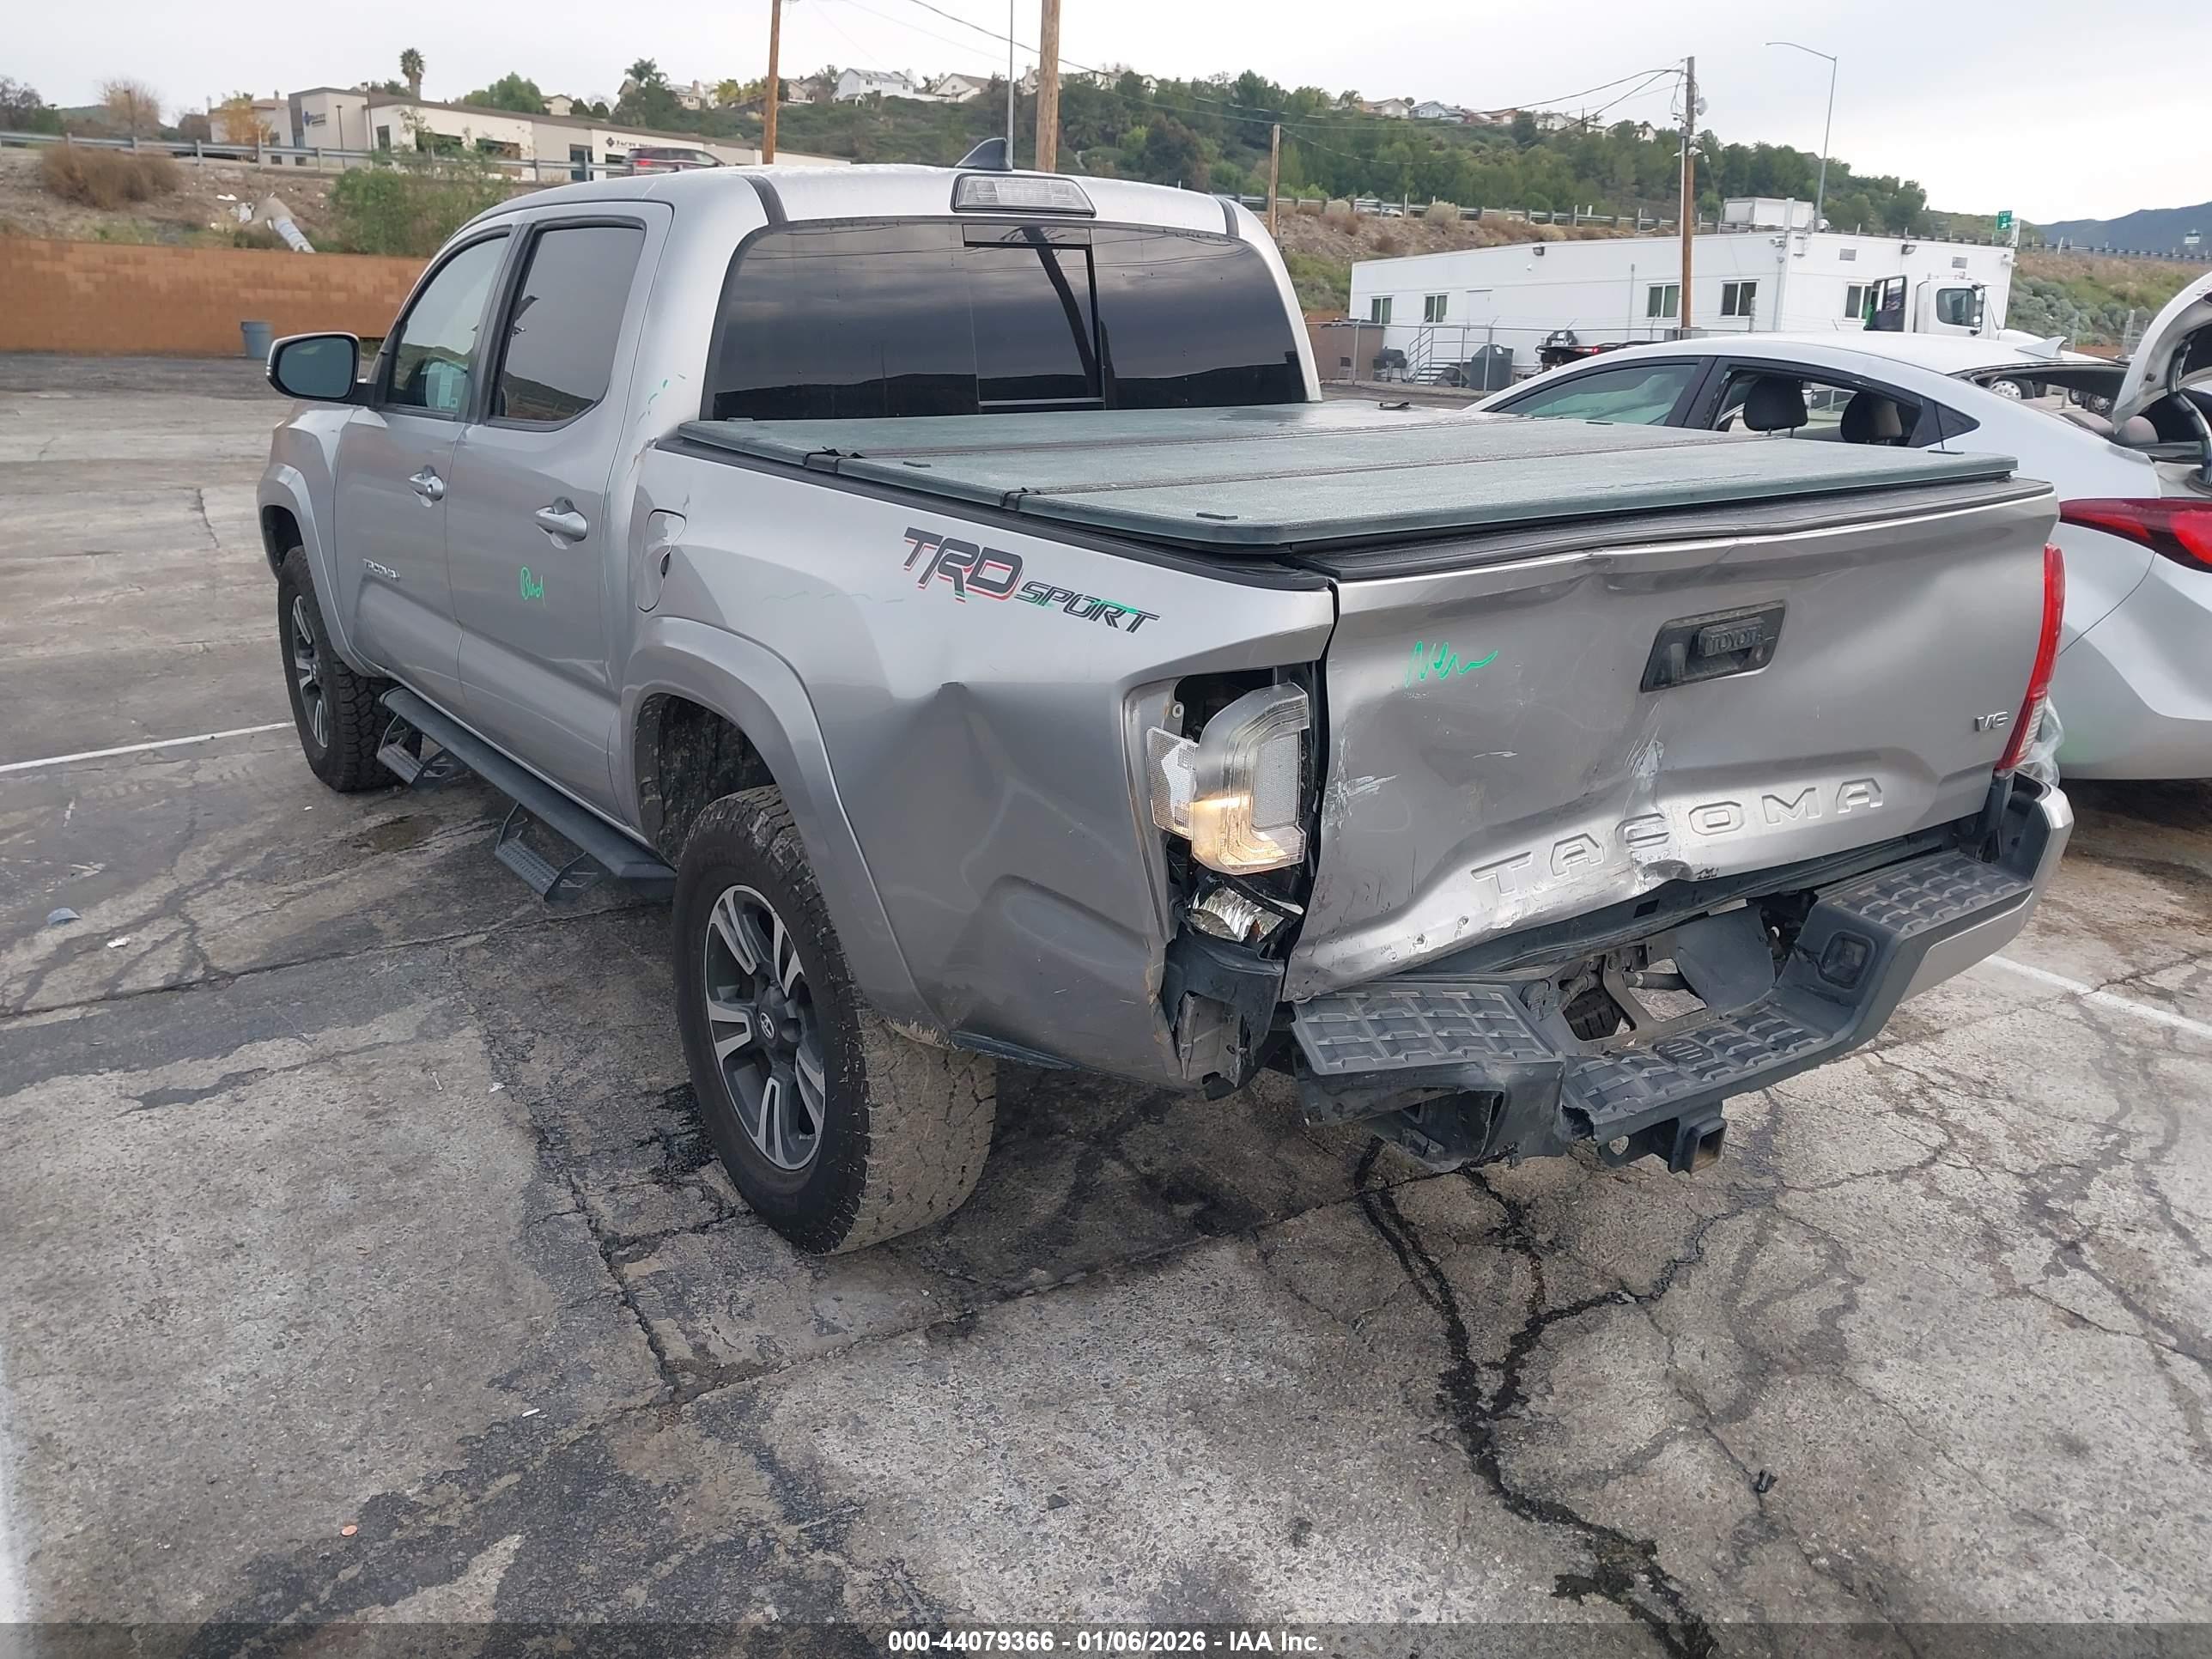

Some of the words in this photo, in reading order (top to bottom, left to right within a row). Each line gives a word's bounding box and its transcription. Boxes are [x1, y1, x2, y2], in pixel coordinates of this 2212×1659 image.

[903, 526, 1024, 603] TRD
[1013, 580, 1161, 634] SPORT
[1974, 711, 2009, 732] V6
[1469, 777, 1885, 896] TACOMA
